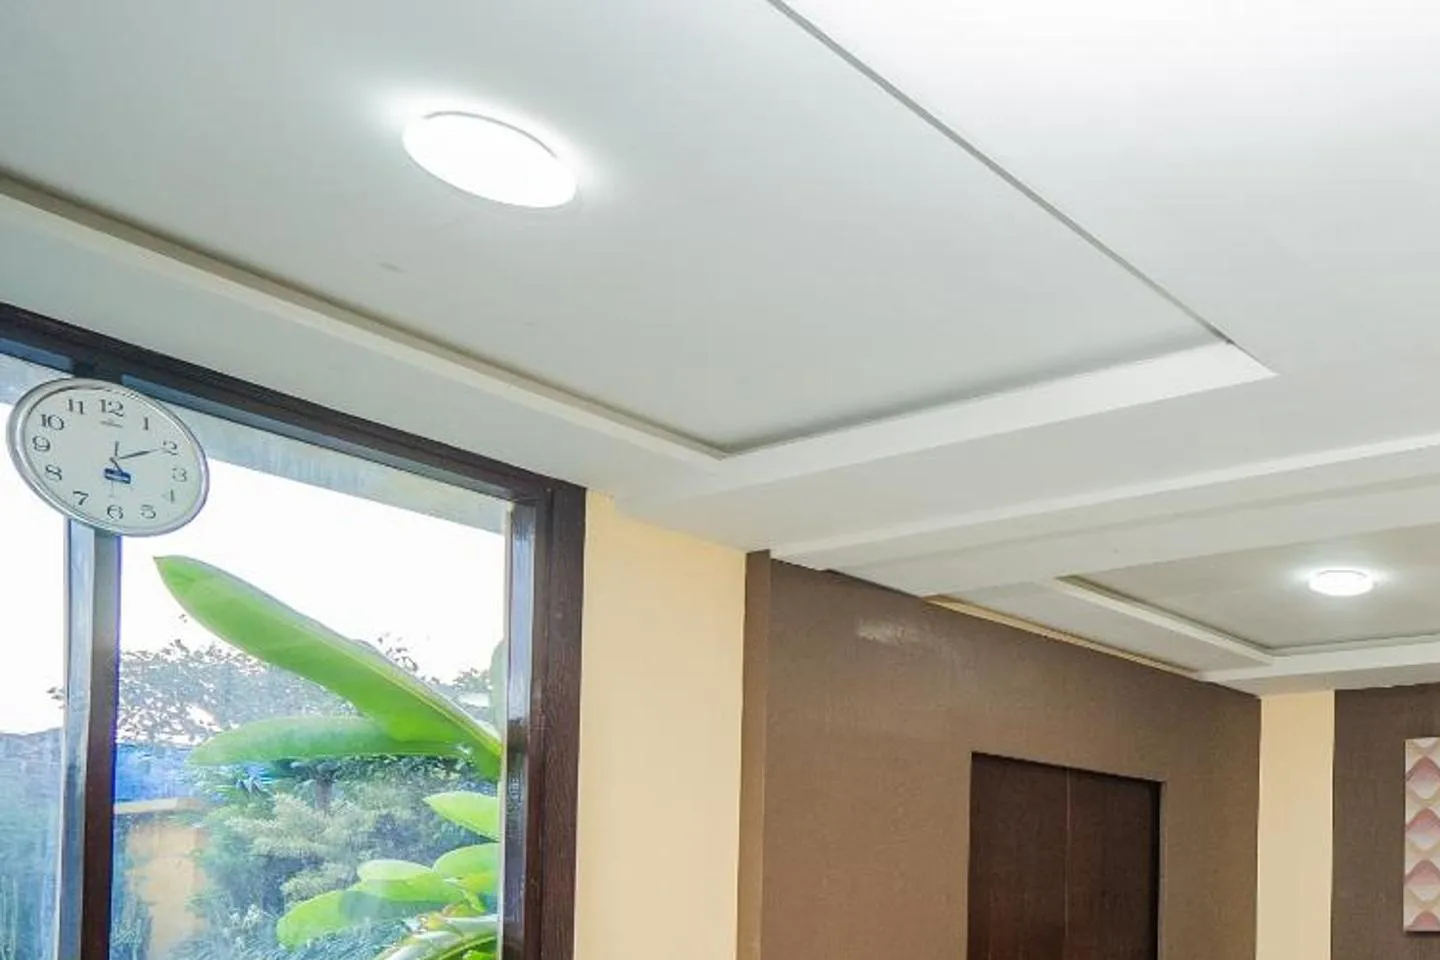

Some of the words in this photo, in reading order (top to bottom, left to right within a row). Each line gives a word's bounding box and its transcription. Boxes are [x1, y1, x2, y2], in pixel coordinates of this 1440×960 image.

[67, 398, 84, 415] 11
[99, 398, 125, 417] 12
[40, 413, 65, 431] 10
[142, 416, 149, 430] 1
[32, 434, 51, 453] 9
[162, 440, 178, 456] 2
[45, 463, 63, 481] 8
[172, 466, 188, 483] 3
[72, 490, 89, 506] 7
[162, 488, 176, 503] 4
[107, 503, 124, 520] 6
[140, 503, 157, 520] 5
